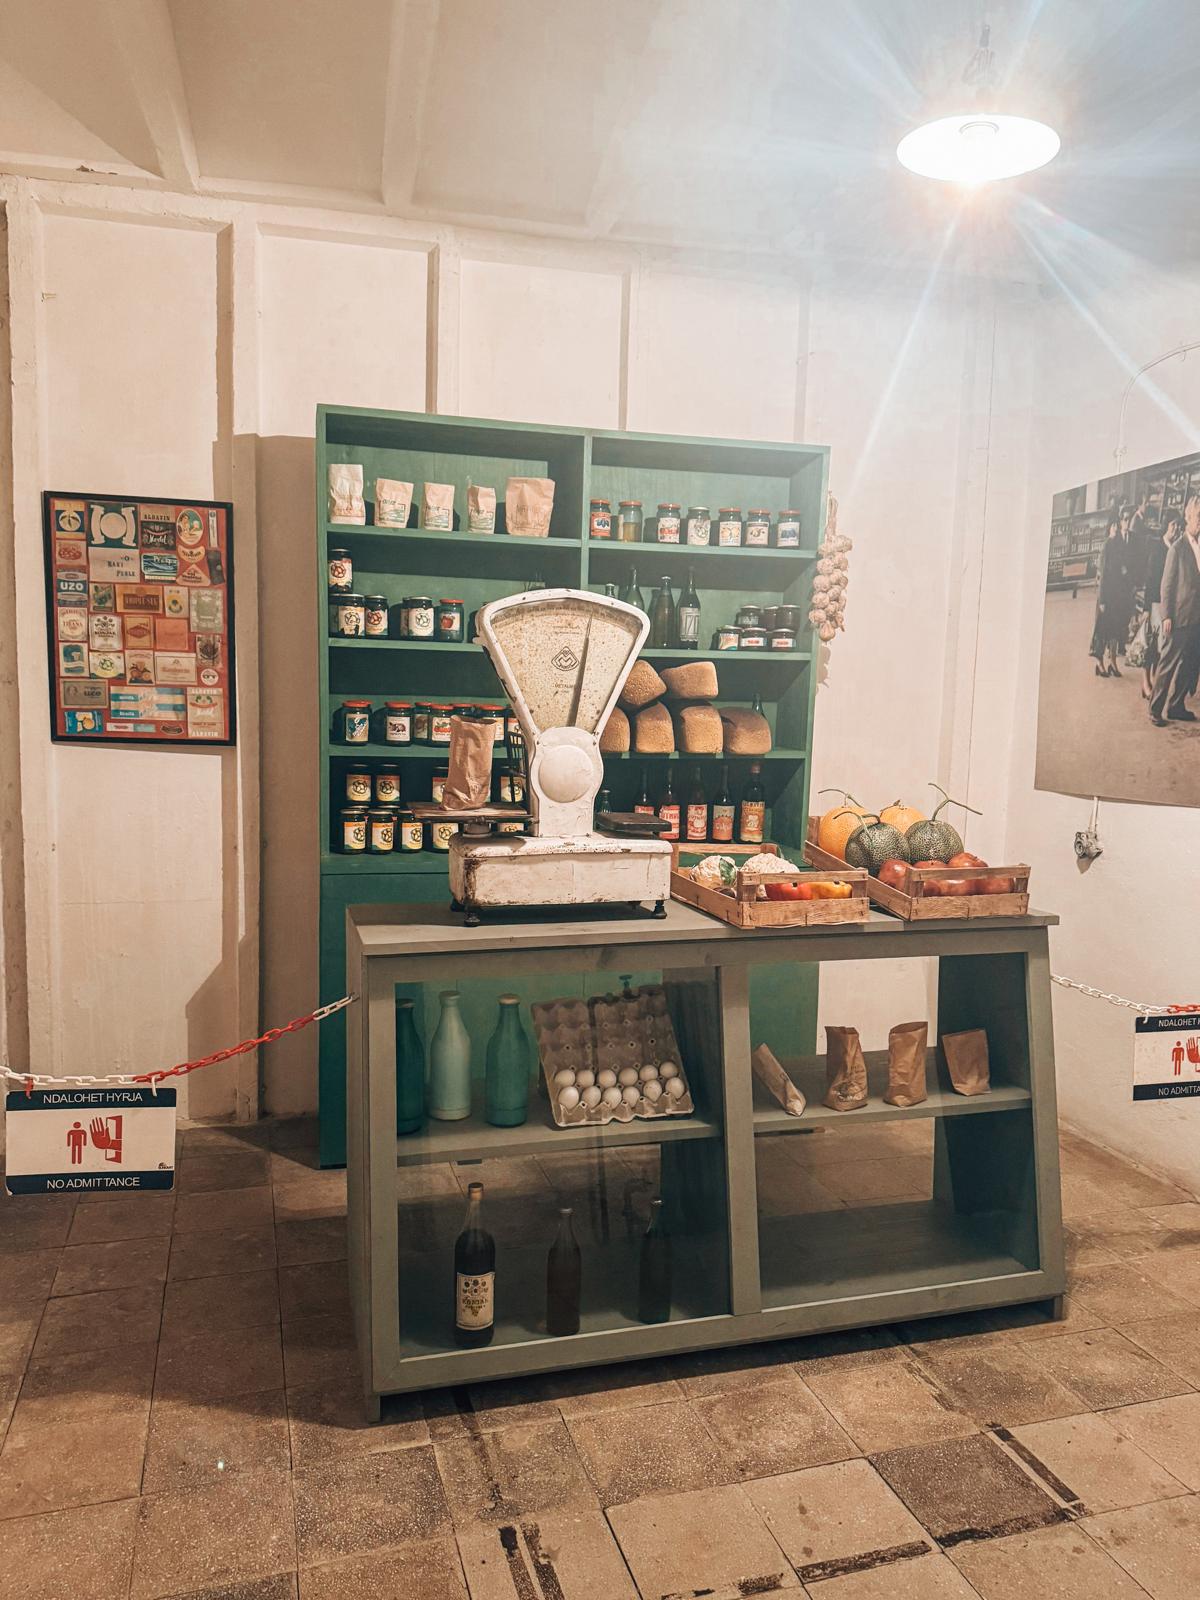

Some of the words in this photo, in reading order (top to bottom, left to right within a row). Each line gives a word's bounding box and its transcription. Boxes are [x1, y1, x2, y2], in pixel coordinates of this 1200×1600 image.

[60, 581, 84, 591] UZO
[1158, 1017, 1197, 1027] NDALOHET
[1158, 1087, 1170, 1096] NO
[43, 1093, 104, 1104] NDALOHET
[106, 1092, 143, 1103] HYRJA
[46, 1179, 65, 1189] NO
[66, 1177, 140, 1188] ADMITTANCE
